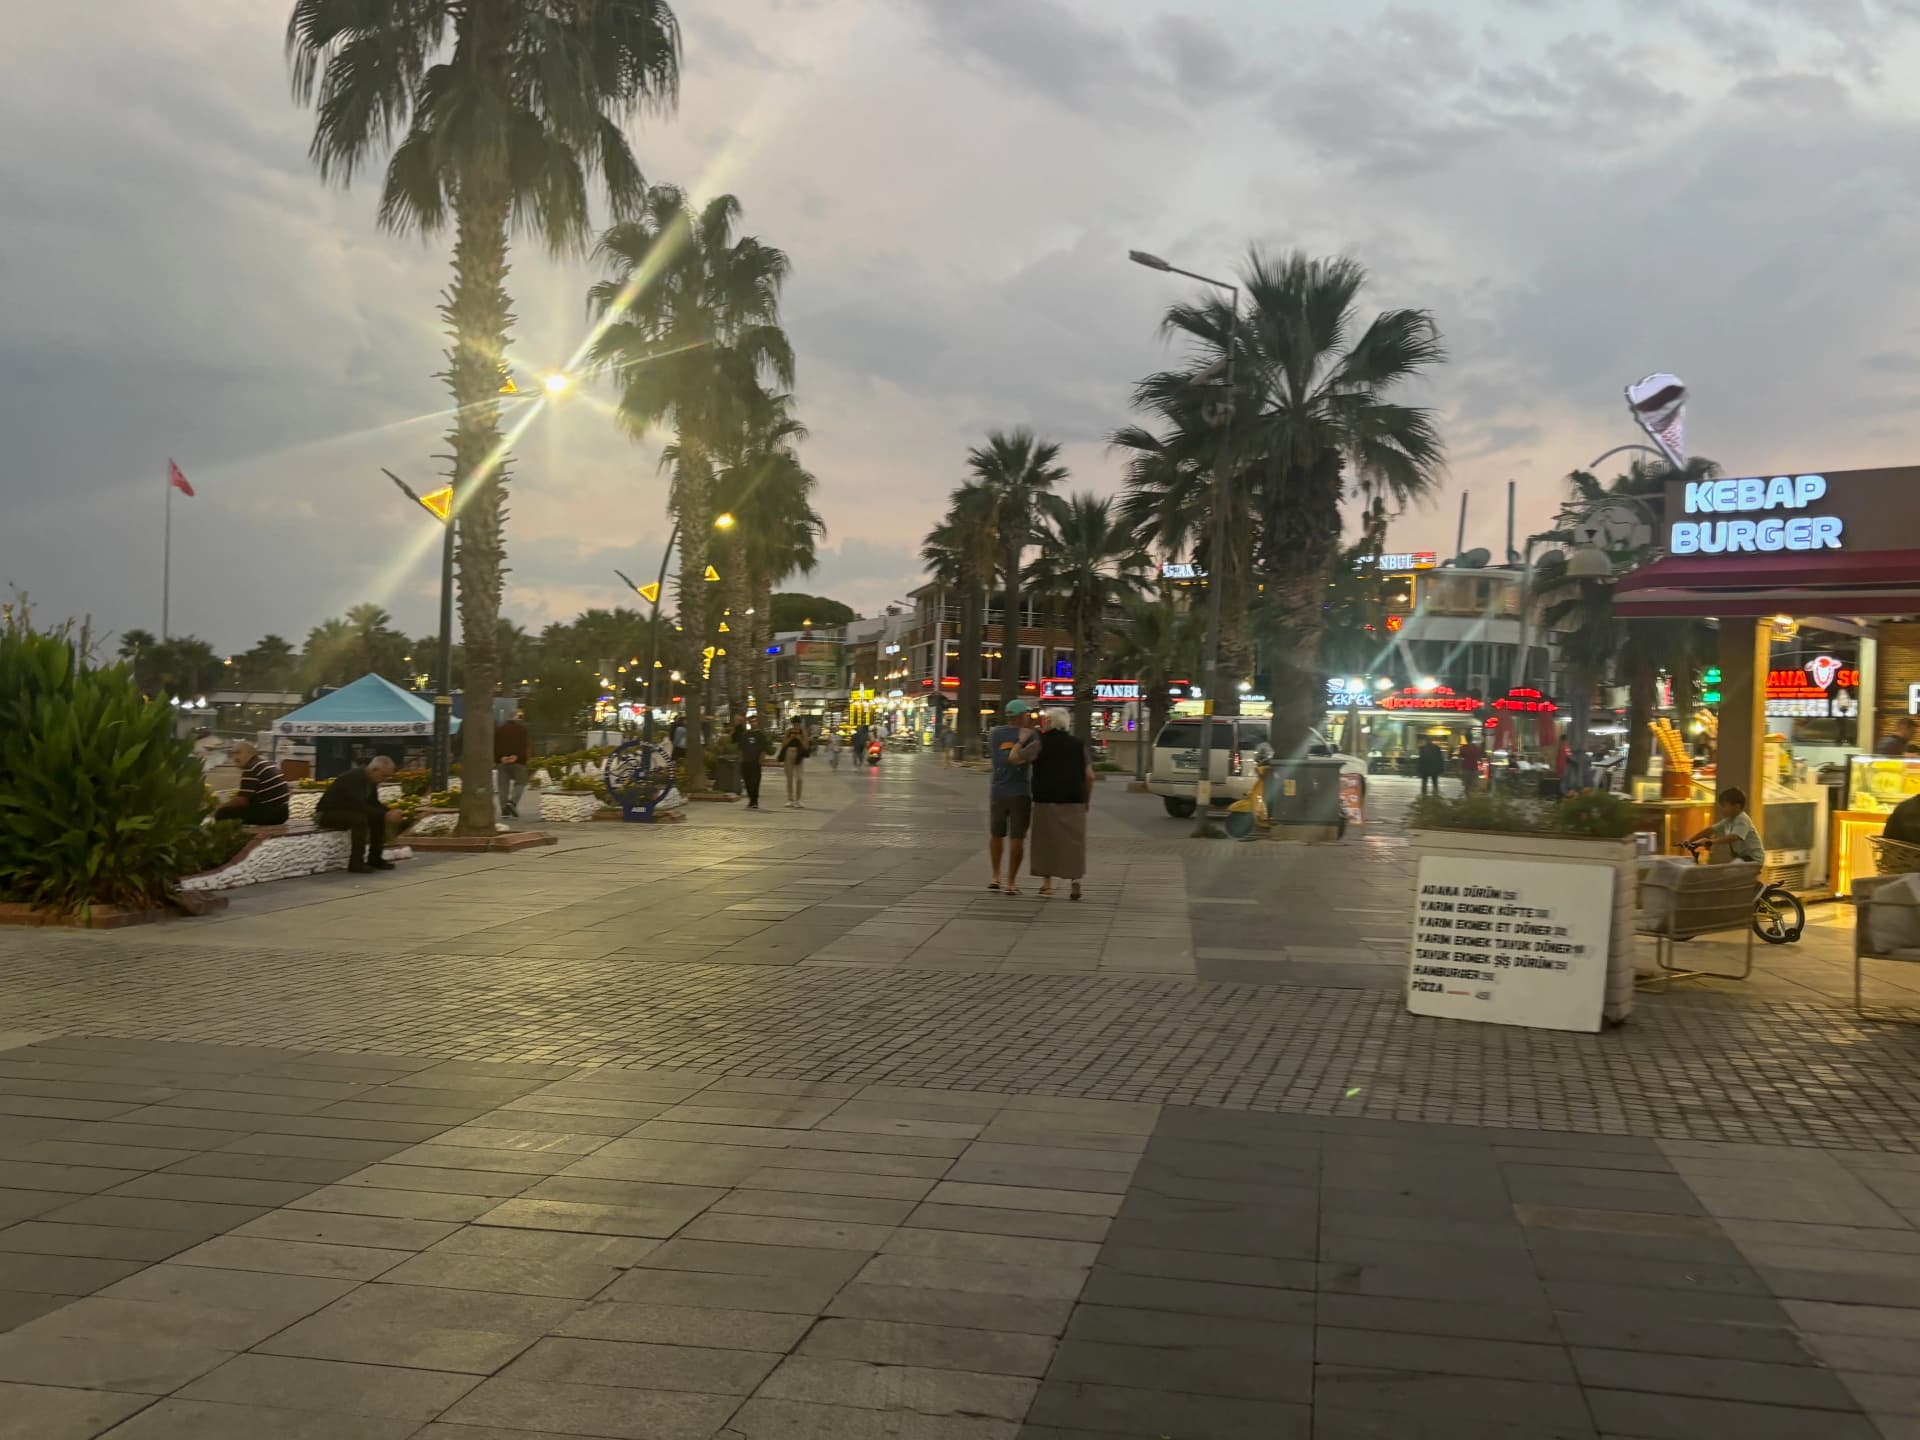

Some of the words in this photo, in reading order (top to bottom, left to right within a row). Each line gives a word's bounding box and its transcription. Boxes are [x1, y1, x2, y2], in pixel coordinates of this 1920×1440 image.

[1685, 474, 1826, 513] KEBAP
[1671, 517, 1843, 554] BURGER
[1457, 903, 1495, 915] EKMEK
[1455, 919, 1493, 931] EKMEK
[1496, 922, 1512, 933] ET
[1514, 921, 1552, 936] DÖNER
[1454, 936, 1492, 947] EKMEK
[1495, 938, 1532, 951] TAVUK
[1534, 939, 1572, 954] DÖNER
[1415, 948, 1451, 960] TAVUK
[1453, 951, 1491, 963] EKMEK
[1413, 964, 1480, 980] HAMBURGER
[1411, 978, 1443, 993] PİZZA
